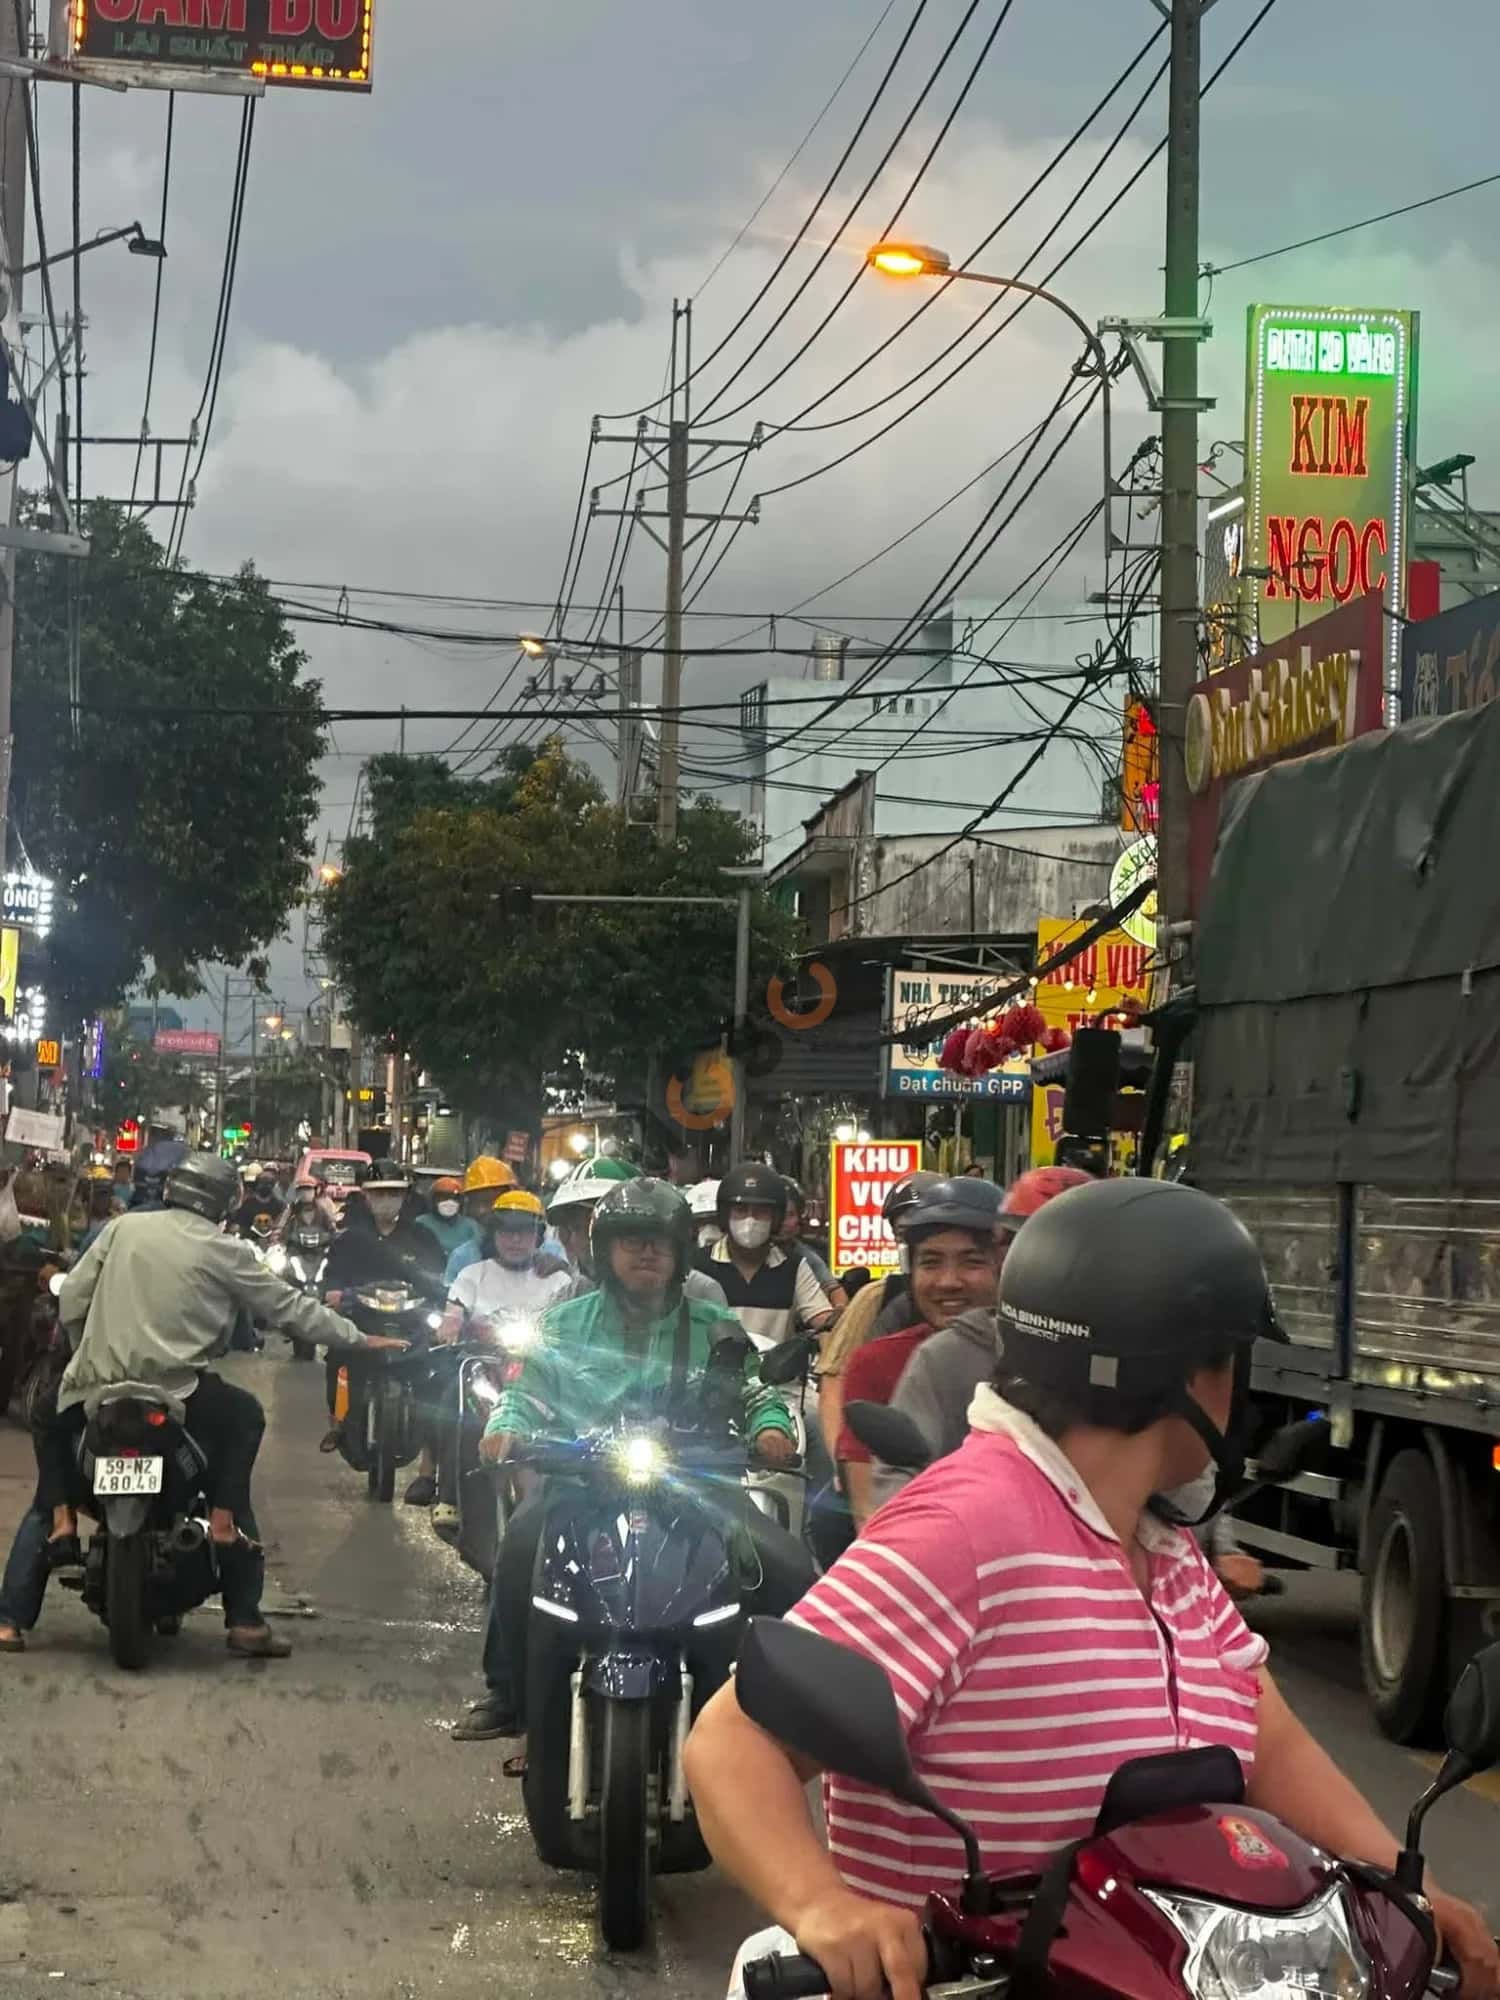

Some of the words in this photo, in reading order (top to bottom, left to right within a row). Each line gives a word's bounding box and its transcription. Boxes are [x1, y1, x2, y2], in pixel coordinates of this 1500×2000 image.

[1290, 395, 1370, 477] KIM
[900, 976, 931, 1003] NHÀ
[899, 1075, 928, 1094] Đạt
[844, 1147, 910, 1173] KHU
[1049, 1317, 1090, 1338] MINH
[106, 1459, 153, 1475] 59-N2
[98, 1475, 157, 1491] 480.48
